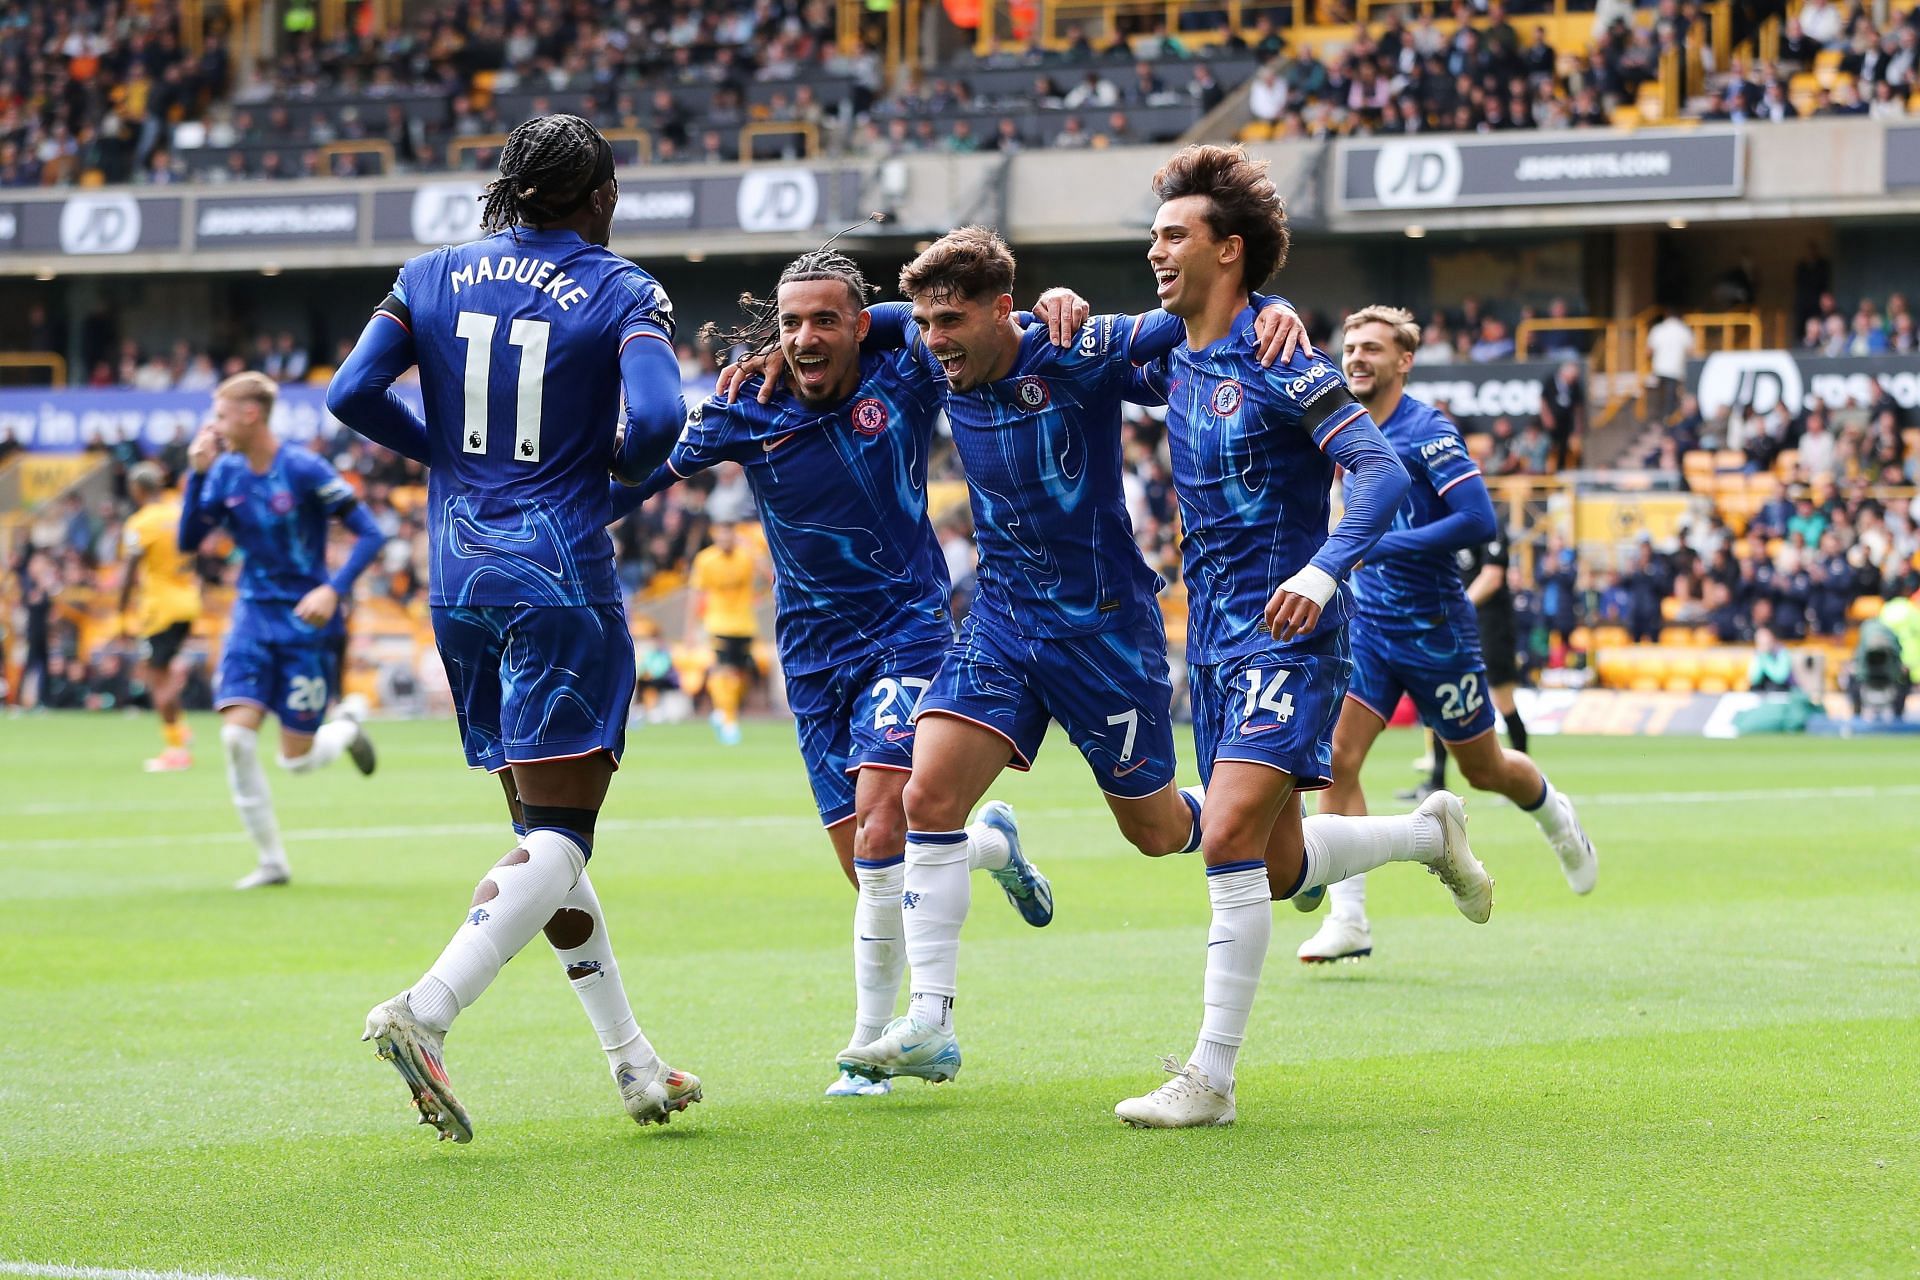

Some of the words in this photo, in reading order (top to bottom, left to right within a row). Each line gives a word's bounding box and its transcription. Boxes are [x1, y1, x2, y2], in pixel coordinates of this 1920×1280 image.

[450, 256, 589, 311] MADUEKE
[456, 311, 551, 463] 11
[1285, 362, 1330, 400] fever
[1302, 379, 1341, 408] feverup.com
[1421, 435, 1458, 460] fever
[286, 674, 327, 711] 20
[871, 676, 931, 731] 27
[1242, 669, 1295, 723] 14
[1435, 672, 1484, 720] 22
[1107, 708, 1138, 762] 7
